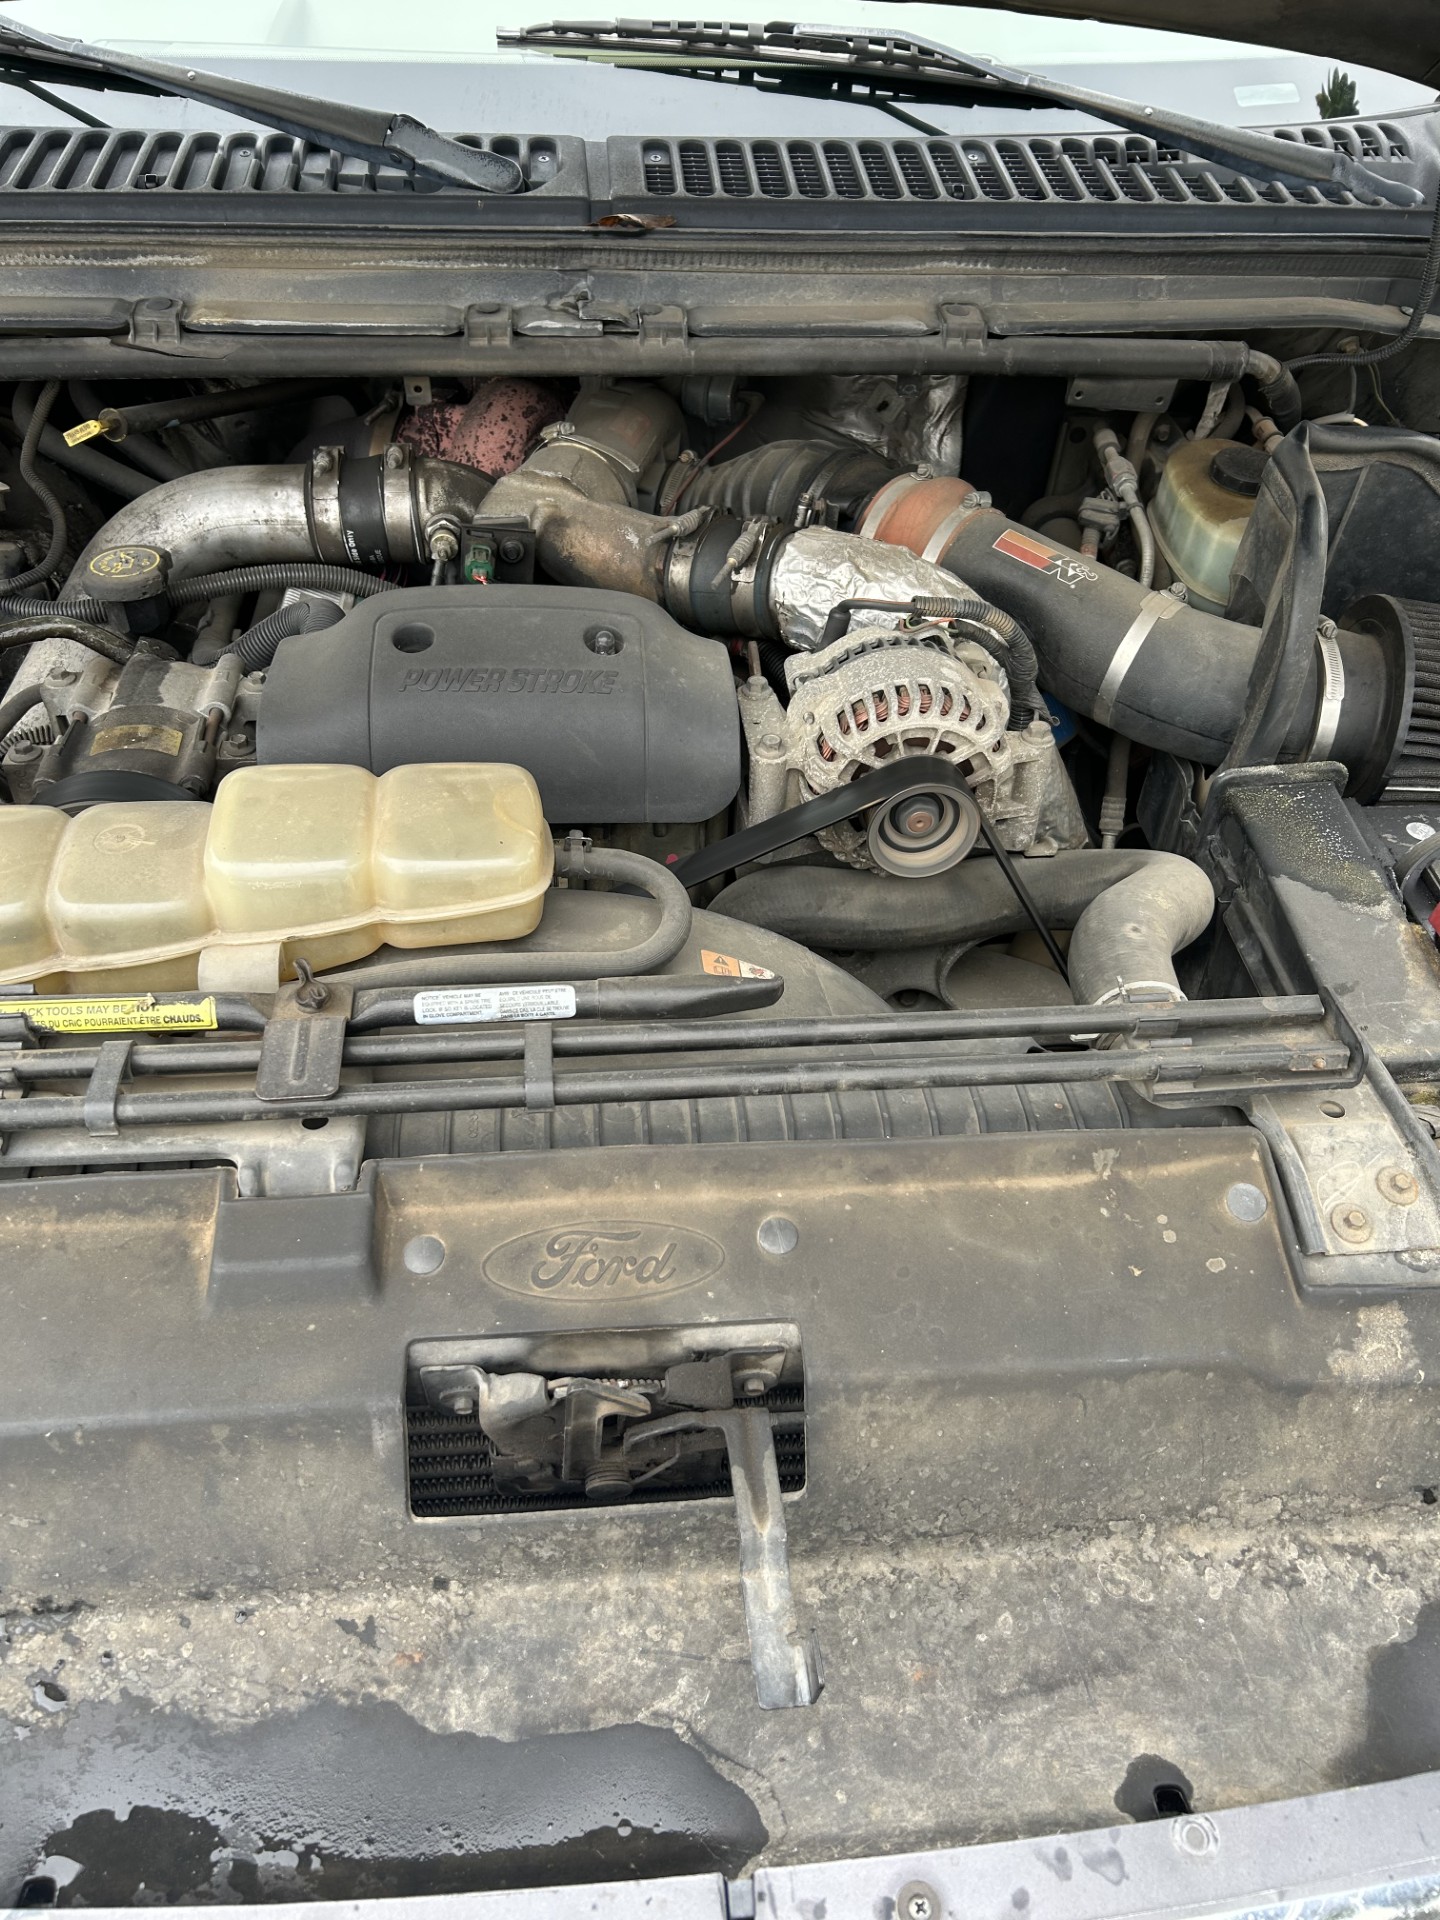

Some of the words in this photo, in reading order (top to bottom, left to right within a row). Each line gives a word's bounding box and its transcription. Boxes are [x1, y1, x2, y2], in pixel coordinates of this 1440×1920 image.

[398, 668, 507, 693] POWER
[507, 668, 619, 694] STROKE
[46, 1005, 84, 1016] TOOLS
[86, 1004, 111, 1014] MAY
[49, 1019, 61, 1028] DU
[62, 1018, 84, 1028] CRIC
[85, 1016, 138, 1027] POURRAIENT
[139, 1014, 161, 1025] ÊTRE
[163, 1014, 205, 1024] CHAUDS.
[531, 1230, 678, 1290] Ford
